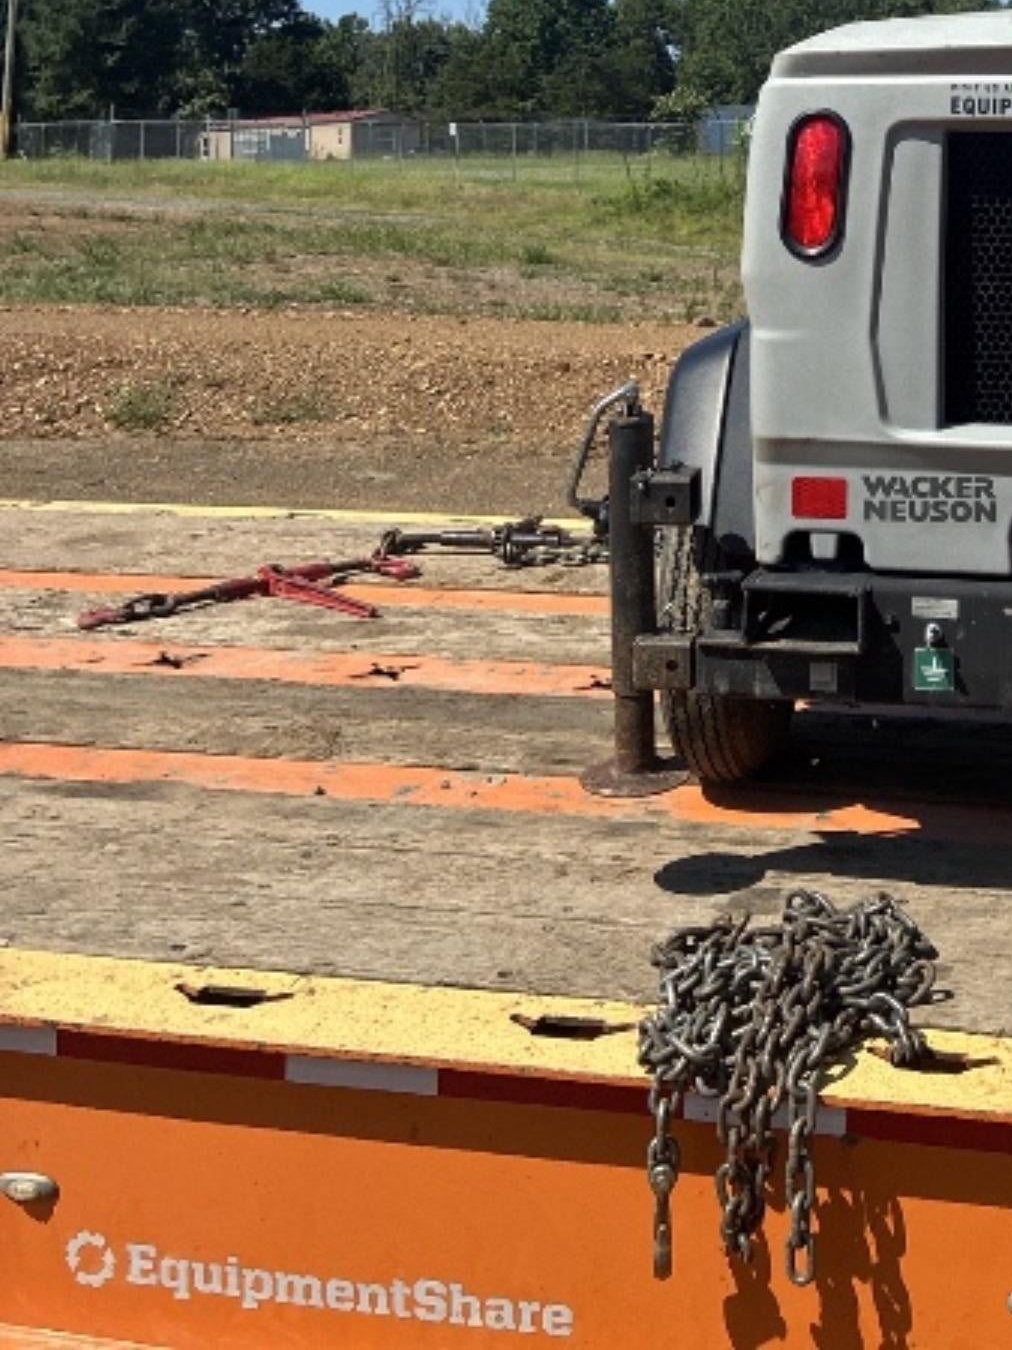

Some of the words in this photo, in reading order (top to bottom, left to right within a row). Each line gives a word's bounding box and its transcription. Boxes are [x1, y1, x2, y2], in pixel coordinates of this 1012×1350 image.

[862, 475, 996, 499] WACKER
[863, 499, 997, 523] NEUSON
[125, 1243, 575, 1338] EquipmentShare
